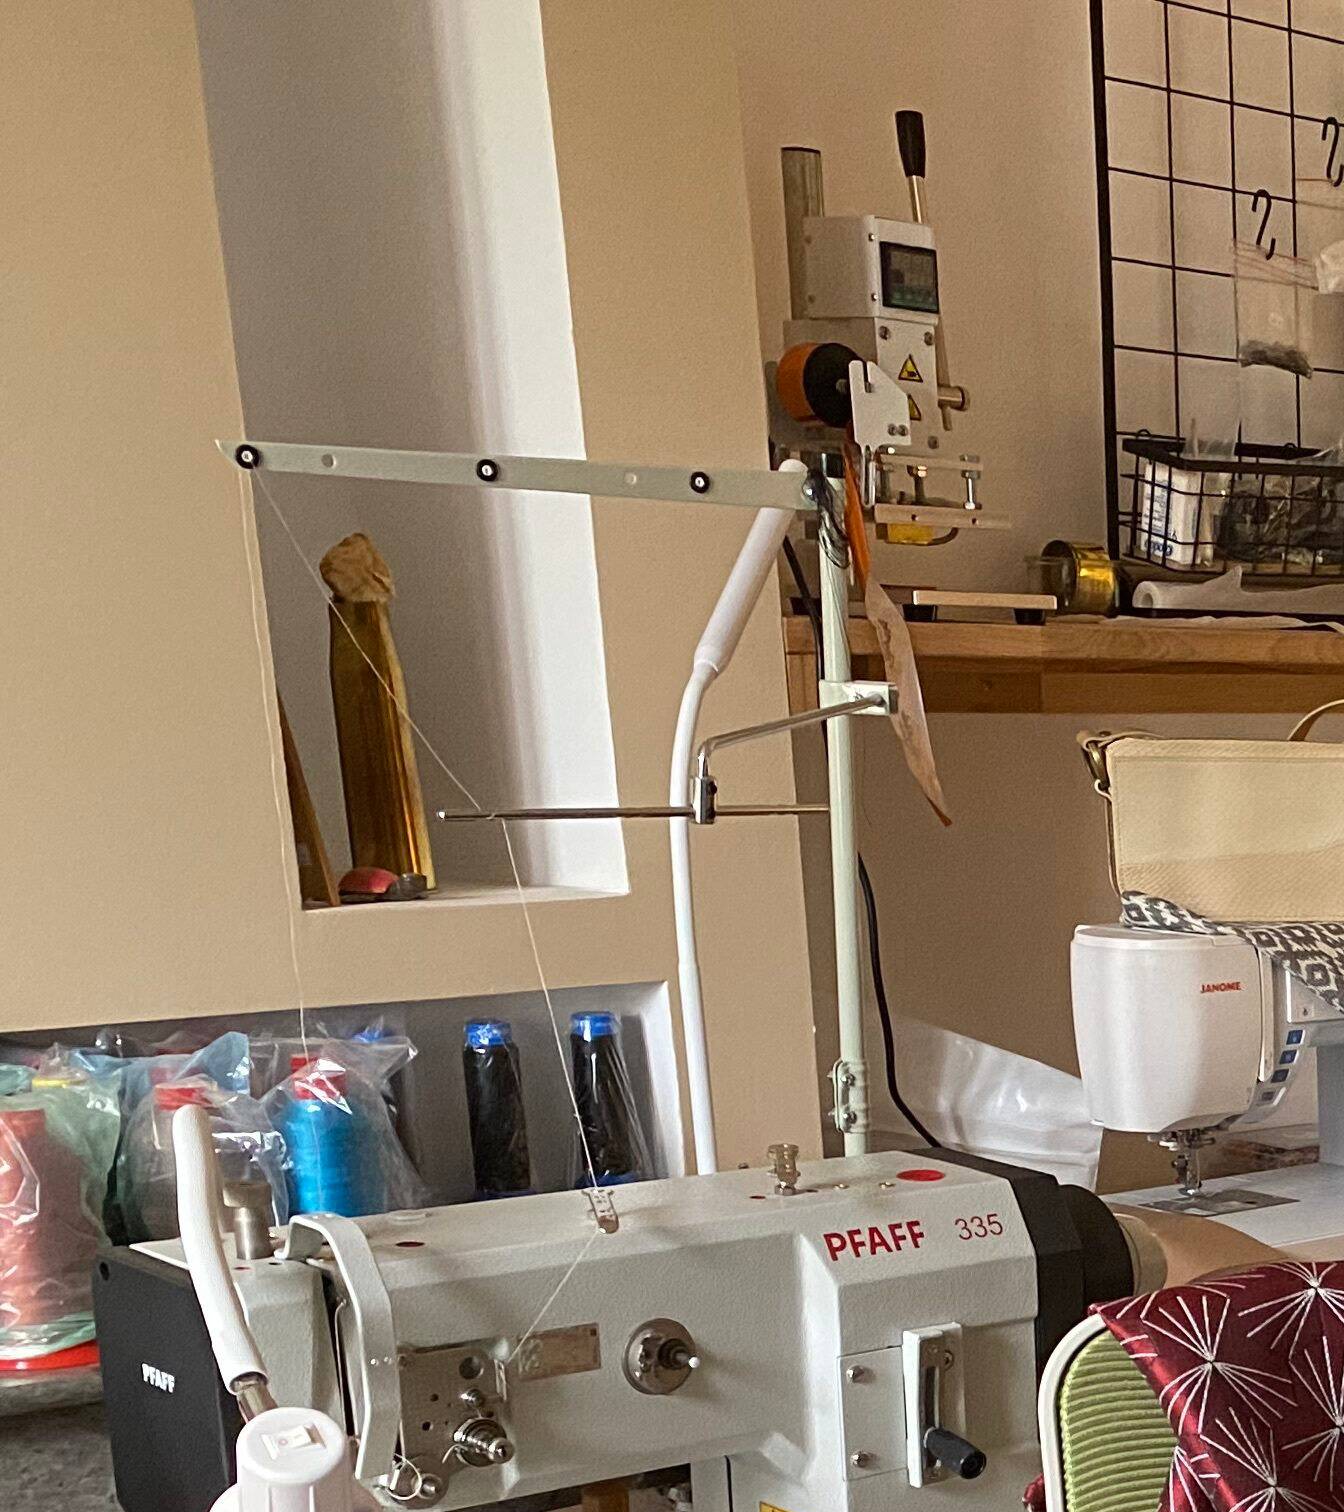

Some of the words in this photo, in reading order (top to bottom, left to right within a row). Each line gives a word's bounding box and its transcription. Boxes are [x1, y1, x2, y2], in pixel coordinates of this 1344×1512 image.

[1200, 981, 1241, 993] JANOME
[823, 1220, 925, 1262] PFAFF
[954, 1213, 1004, 1240] 335
[141, 1363, 175, 1393] PFAFF
